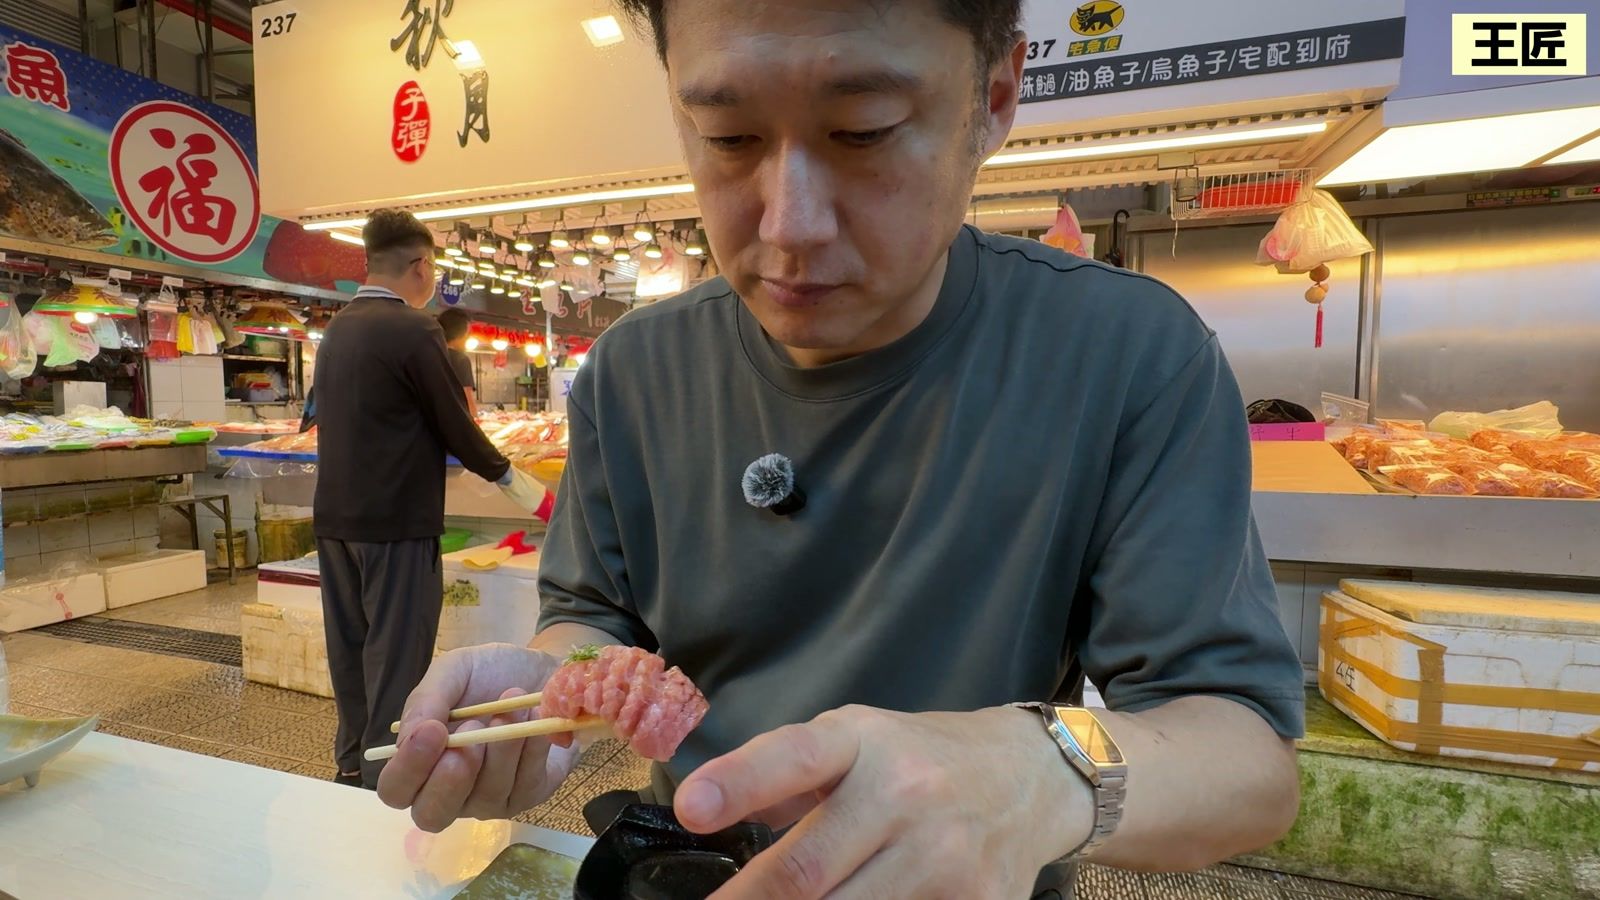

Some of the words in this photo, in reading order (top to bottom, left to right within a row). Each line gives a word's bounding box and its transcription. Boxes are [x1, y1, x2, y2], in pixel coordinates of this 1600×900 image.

[261, 13, 296, 37] 237
[1070, 36, 1121, 56] 宅急便
[5, 43, 69, 111] 魚
[396, 87, 428, 157] 子彈
[138, 127, 237, 246] 福
